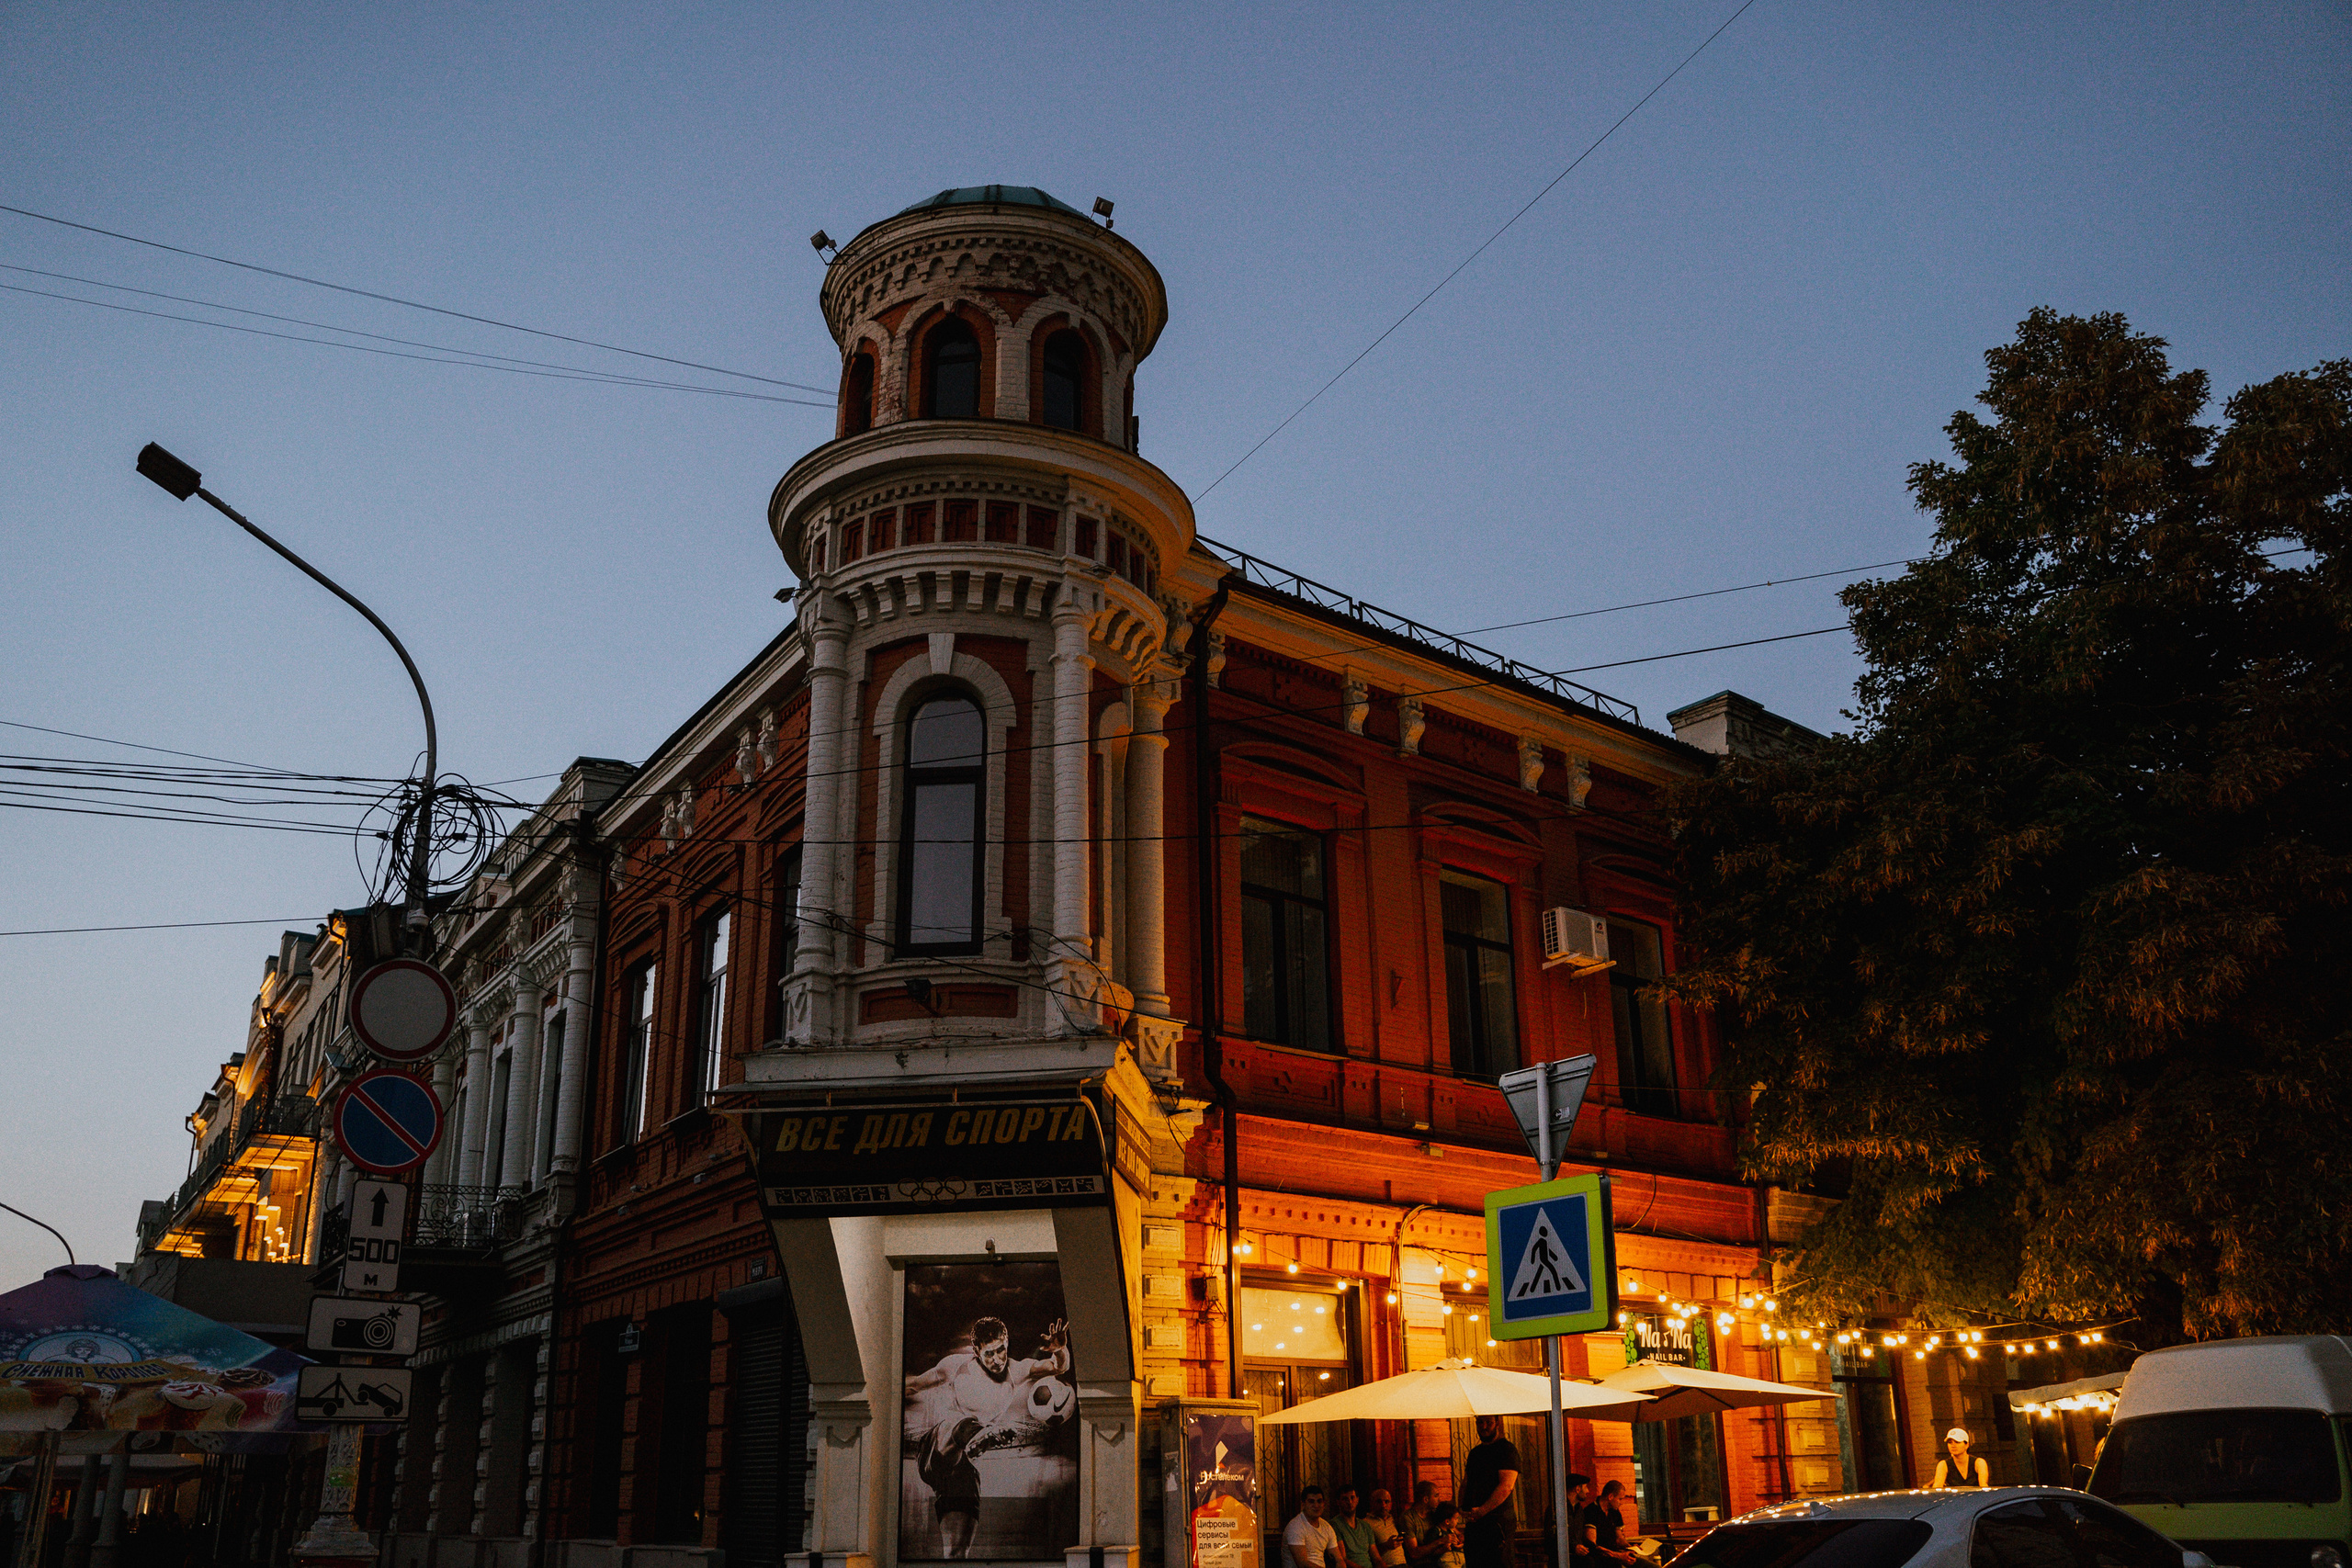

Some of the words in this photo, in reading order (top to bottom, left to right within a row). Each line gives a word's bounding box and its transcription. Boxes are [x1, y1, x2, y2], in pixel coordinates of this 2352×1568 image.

[775, 1116, 849, 1152] ВСЕ
[854, 1112, 933, 1155] ДЛЯ
[944, 1105, 1086, 1146] СПОРТА
[348, 1237, 400, 1264] 500
[1639, 1324, 1661, 1348] Na
[1670, 1326, 1692, 1349] Na
[1196, 1519, 1236, 1529] Цифровые
[1197, 1531, 1228, 1540] сервисы
